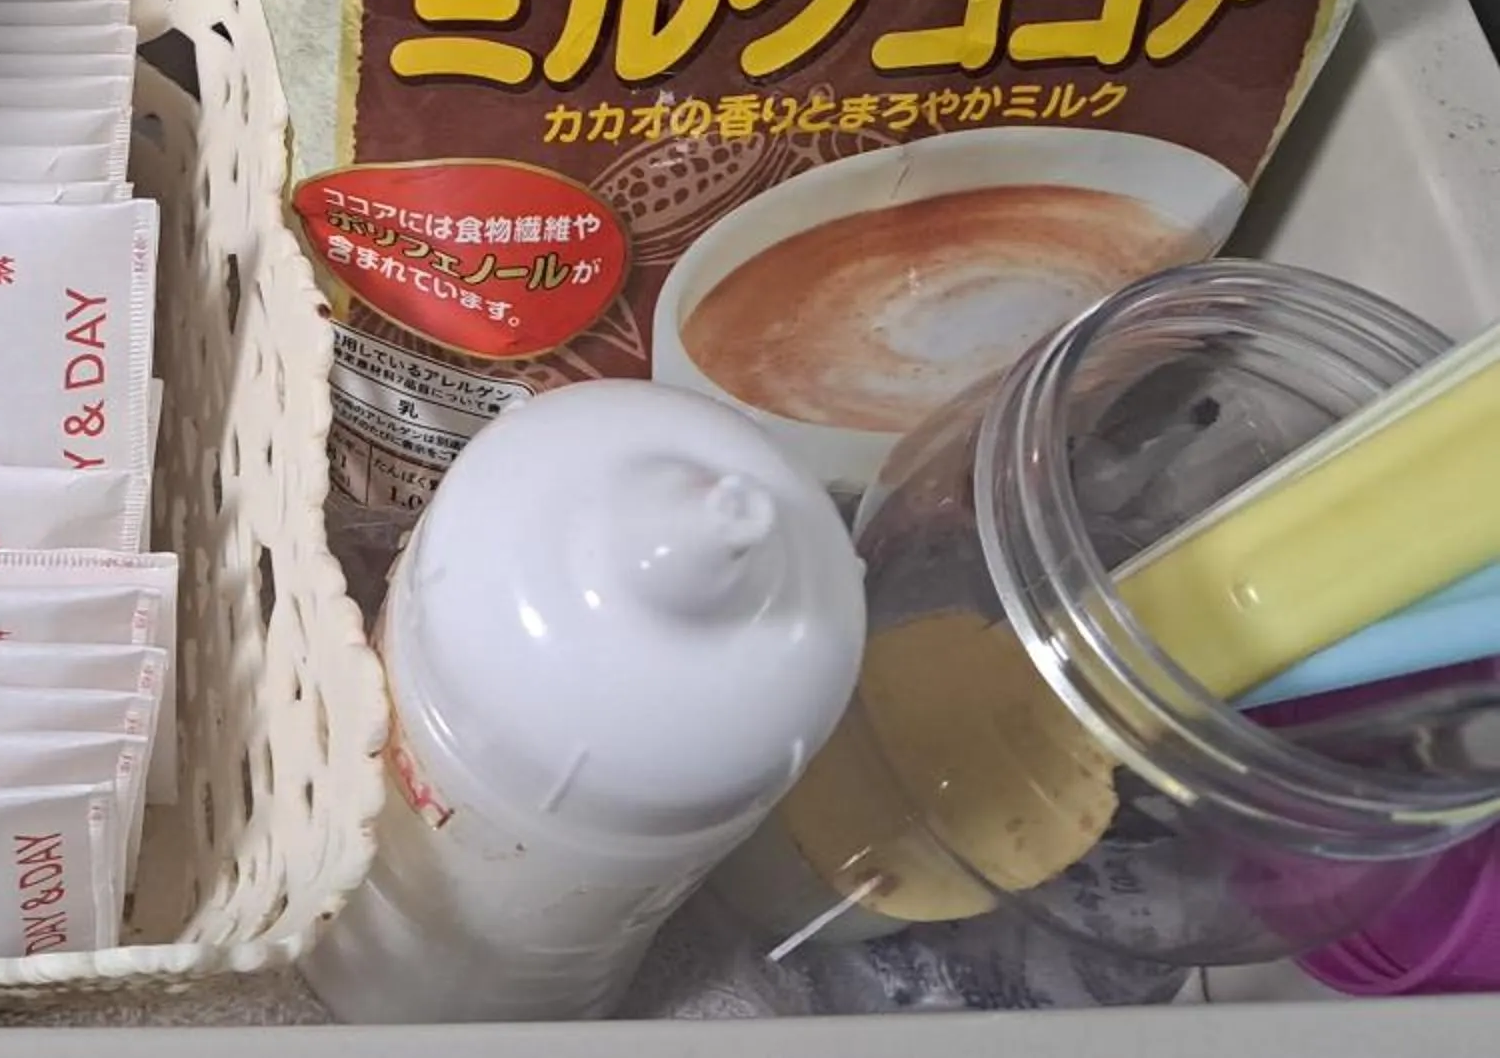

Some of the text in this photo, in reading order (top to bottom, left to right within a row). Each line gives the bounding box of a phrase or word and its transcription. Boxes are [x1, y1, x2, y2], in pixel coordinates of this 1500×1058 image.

[543, 81, 1129, 144] カカオの香りとまろやかミルク
[323, 187, 601, 245] ココアには食物繊維や
[326, 234, 521, 328] 含まれています。
[64, 287, 107, 390] DAY
[62, 399, 106, 437] &
[398, 398, 420, 420] 乳
[14, 833, 63, 889] DAY
[22, 911, 67, 956] DAY
